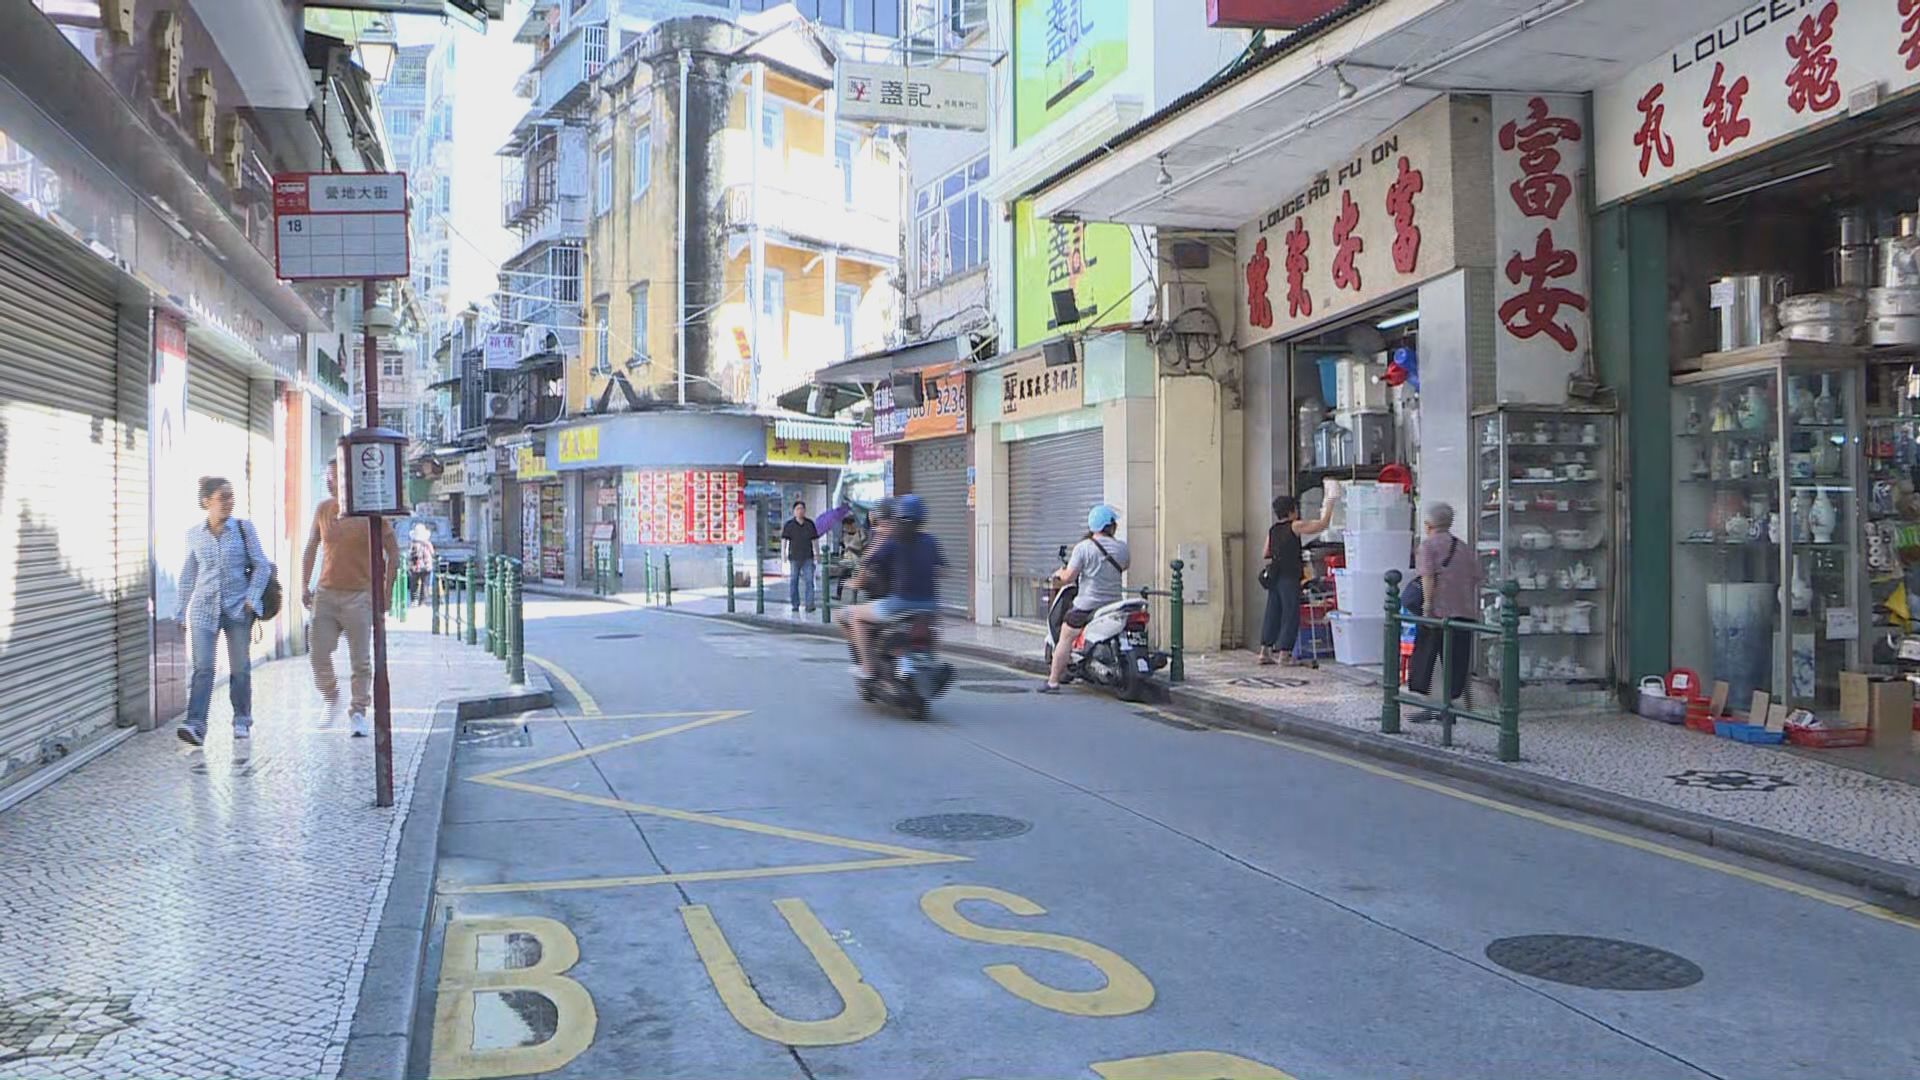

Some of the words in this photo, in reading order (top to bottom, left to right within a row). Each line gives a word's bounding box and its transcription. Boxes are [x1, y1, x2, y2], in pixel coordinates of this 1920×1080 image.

[1337, 157, 1362, 186] FU
[1371, 135, 1399, 166] ON
[325, 185, 389, 200] 營地大街
[287, 219, 303, 233] 18
[1498, 96, 1587, 352] 富安
[935, 384, 966, 415] 3236
[431, 884, 1156, 1080] BUS
